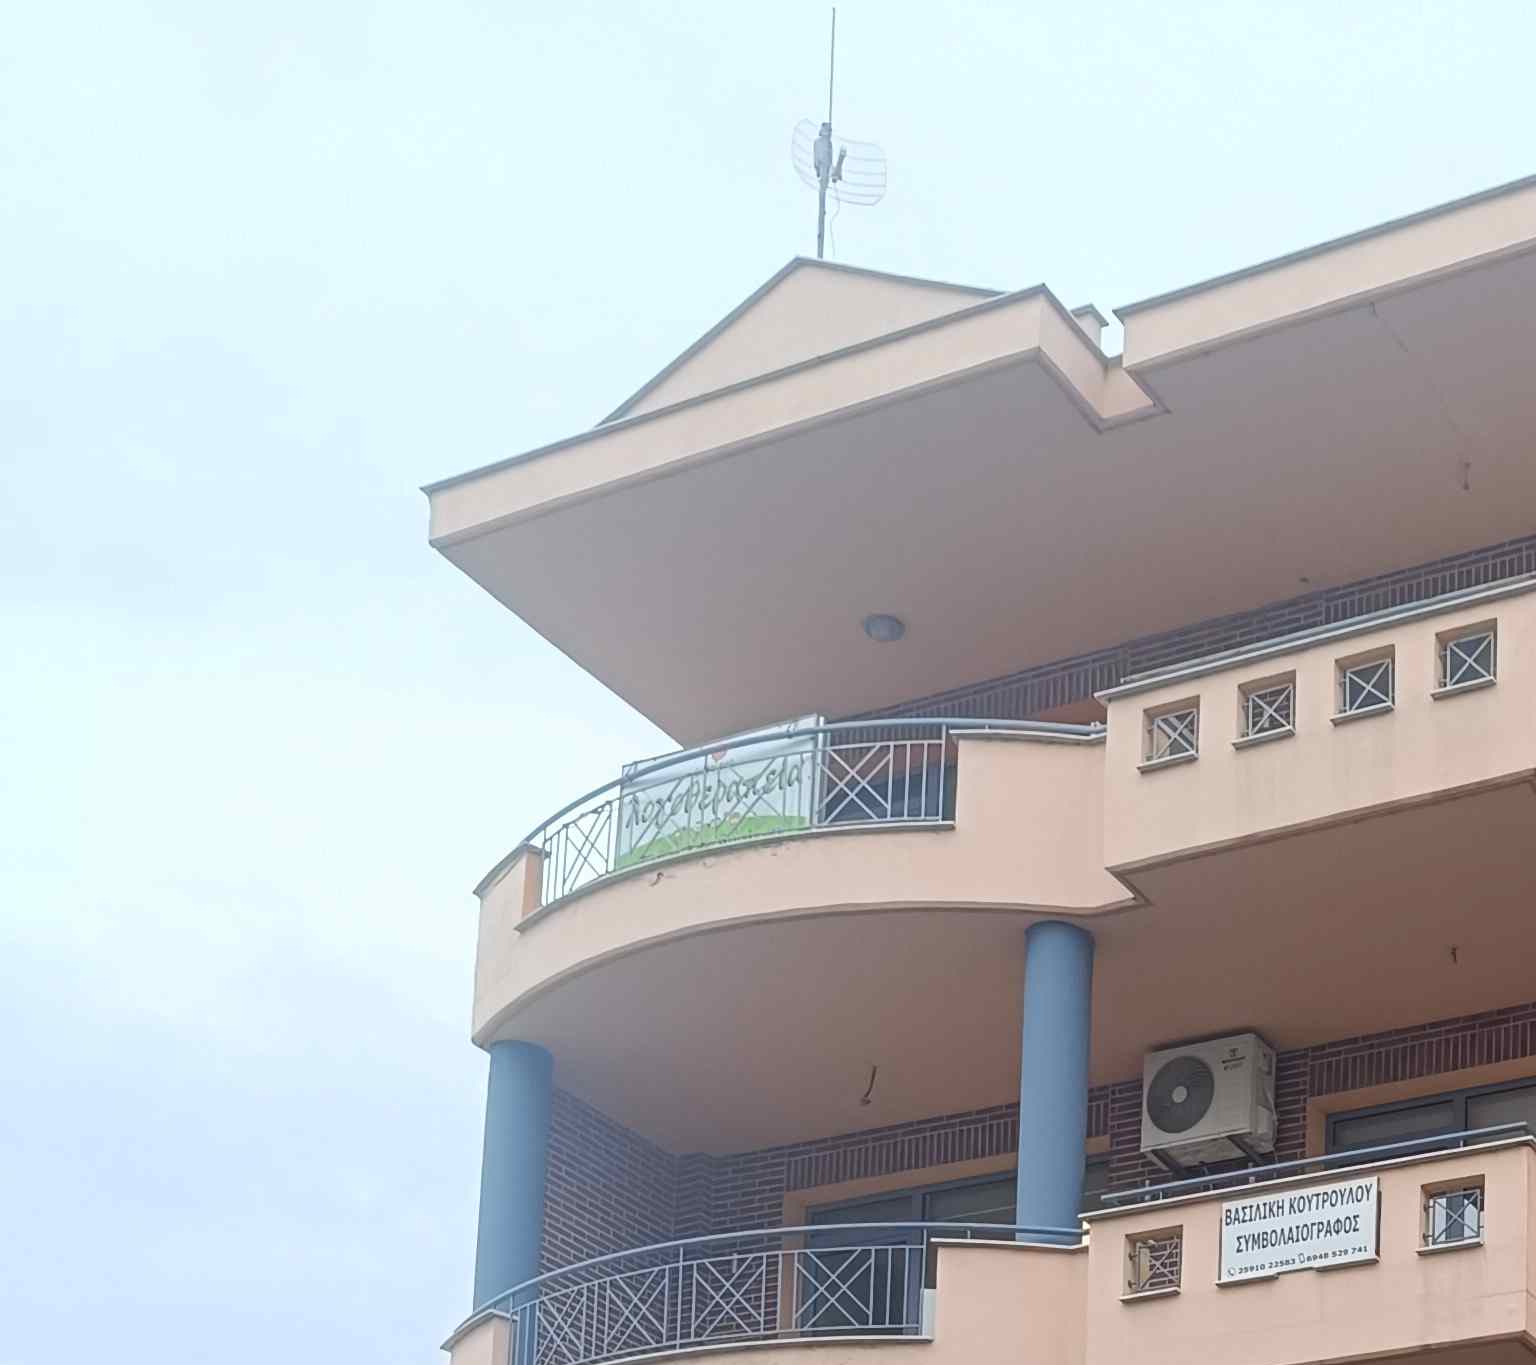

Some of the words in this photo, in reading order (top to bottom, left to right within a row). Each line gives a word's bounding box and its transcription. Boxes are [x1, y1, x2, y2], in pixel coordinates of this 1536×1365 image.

[1225, 1199, 1285, 1226] ΒΑΣΙΛΙΚΗ
[1288, 1183, 1373, 1215] ΚΟΥΤΡΟΥΛΟΥ
[1235, 1214, 1360, 1254] ΣΥΜΒΟΛΑΙΟΓΡΑΦΟΣ
